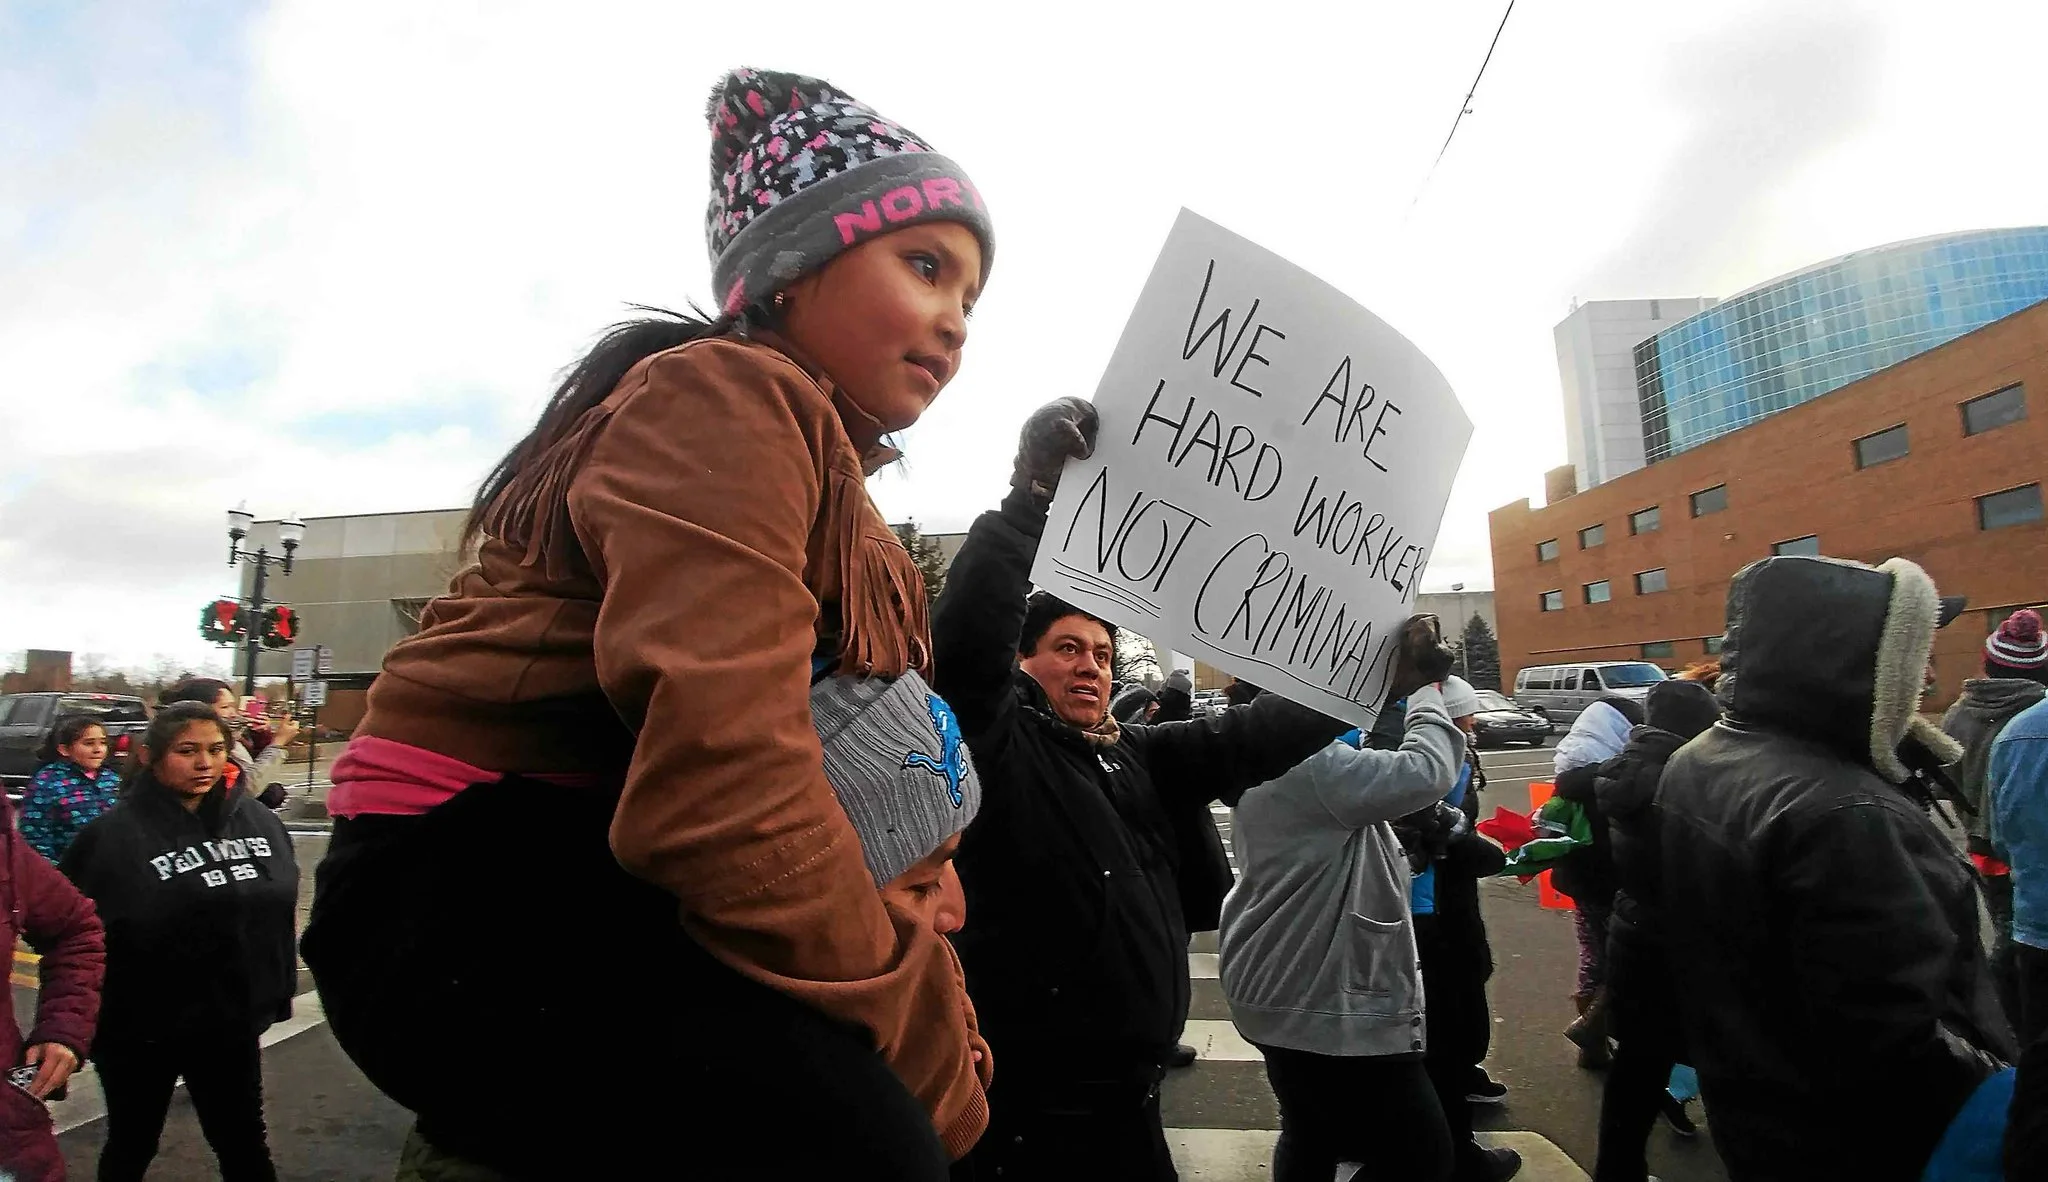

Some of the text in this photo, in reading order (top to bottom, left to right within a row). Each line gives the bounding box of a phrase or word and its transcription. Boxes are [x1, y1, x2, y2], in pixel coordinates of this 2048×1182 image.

[1183, 259, 1402, 472] WE ARE
[1131, 378, 1283, 501] HARD
[1062, 465, 1212, 593] NOT
